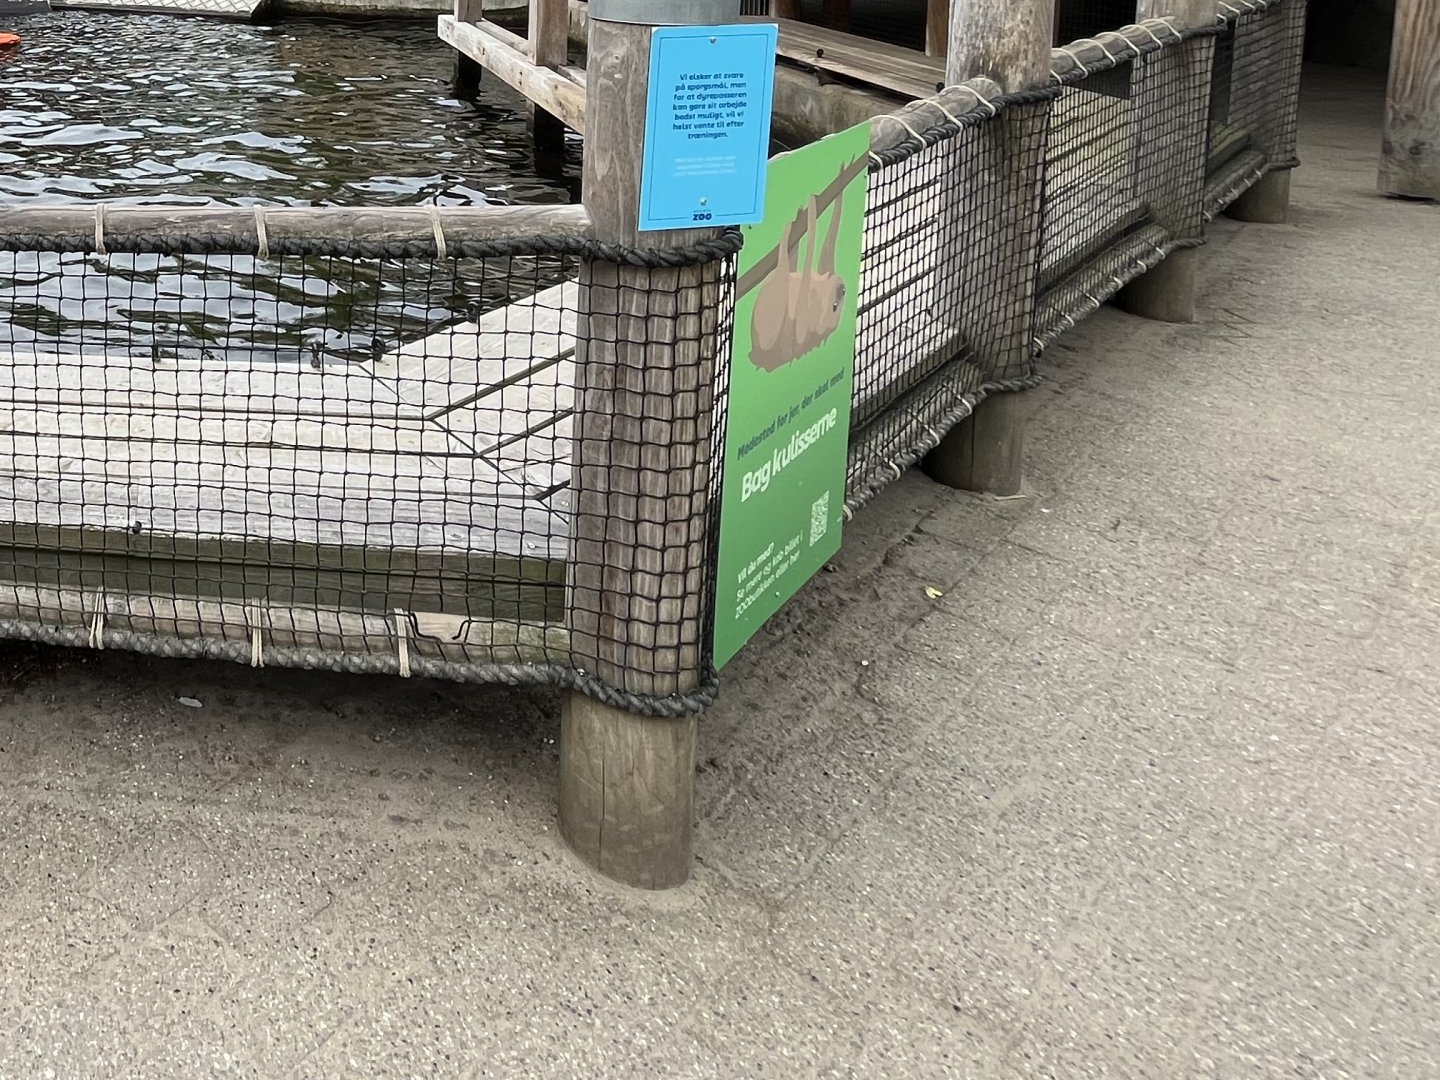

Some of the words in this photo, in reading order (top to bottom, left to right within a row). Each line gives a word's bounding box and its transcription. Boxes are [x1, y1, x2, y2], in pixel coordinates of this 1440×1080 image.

[675, 82, 685, 92] på
[696, 92, 748, 101] dyrepasseren
[718, 100, 747, 109] arbejde
[674, 113, 696, 121] bedst
[726, 110, 736, 118] vil
[726, 120, 745, 128] efter
[741, 460, 771, 502] Bag
[772, 407, 837, 476] kulisserne
[737, 567, 747, 583] Vil
[747, 560, 757, 575] du
[756, 541, 775, 567] med?
[736, 588, 745, 602] Se
[746, 571, 762, 593] mere
[763, 562, 772, 576] og
